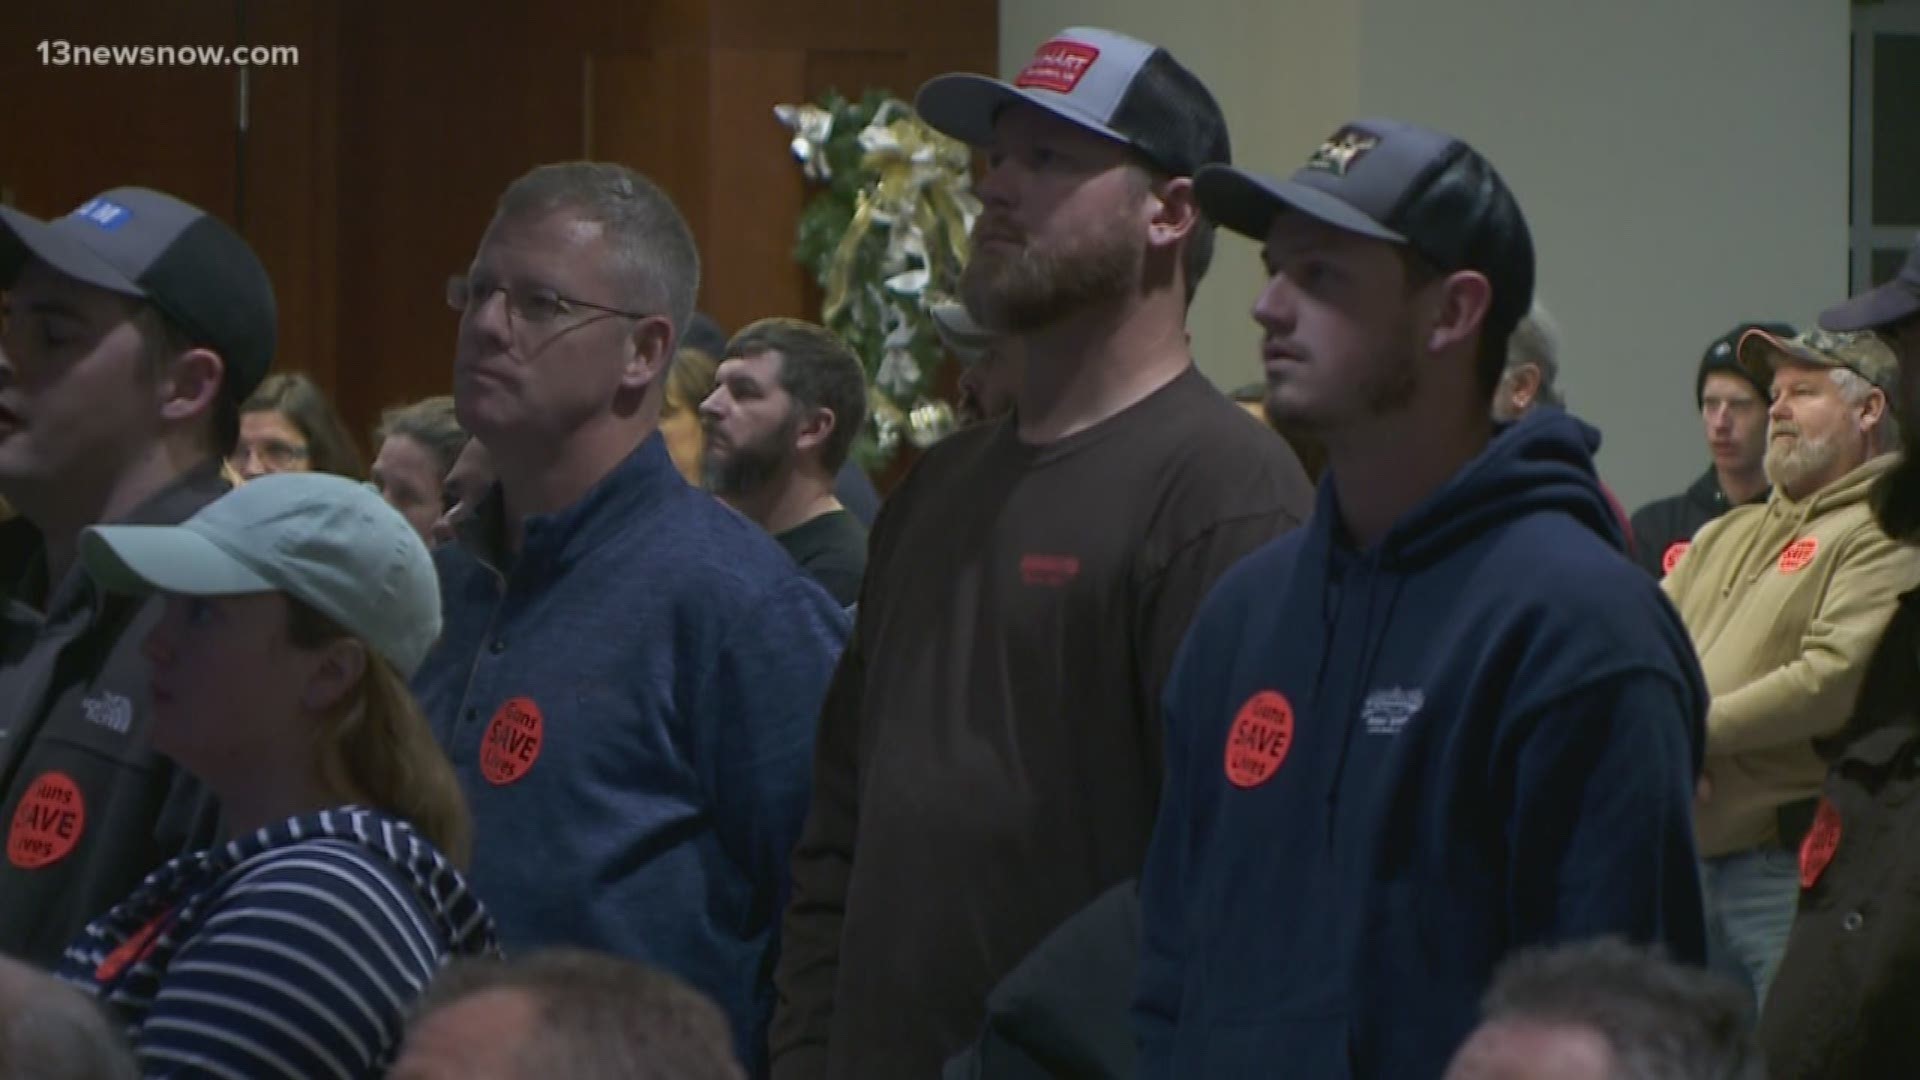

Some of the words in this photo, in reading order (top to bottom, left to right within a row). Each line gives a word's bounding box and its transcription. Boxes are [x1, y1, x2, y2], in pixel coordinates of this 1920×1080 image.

[490, 719, 539, 762] SAVE
[1232, 719, 1287, 757] SAVE
[16, 836, 54, 857] ives
